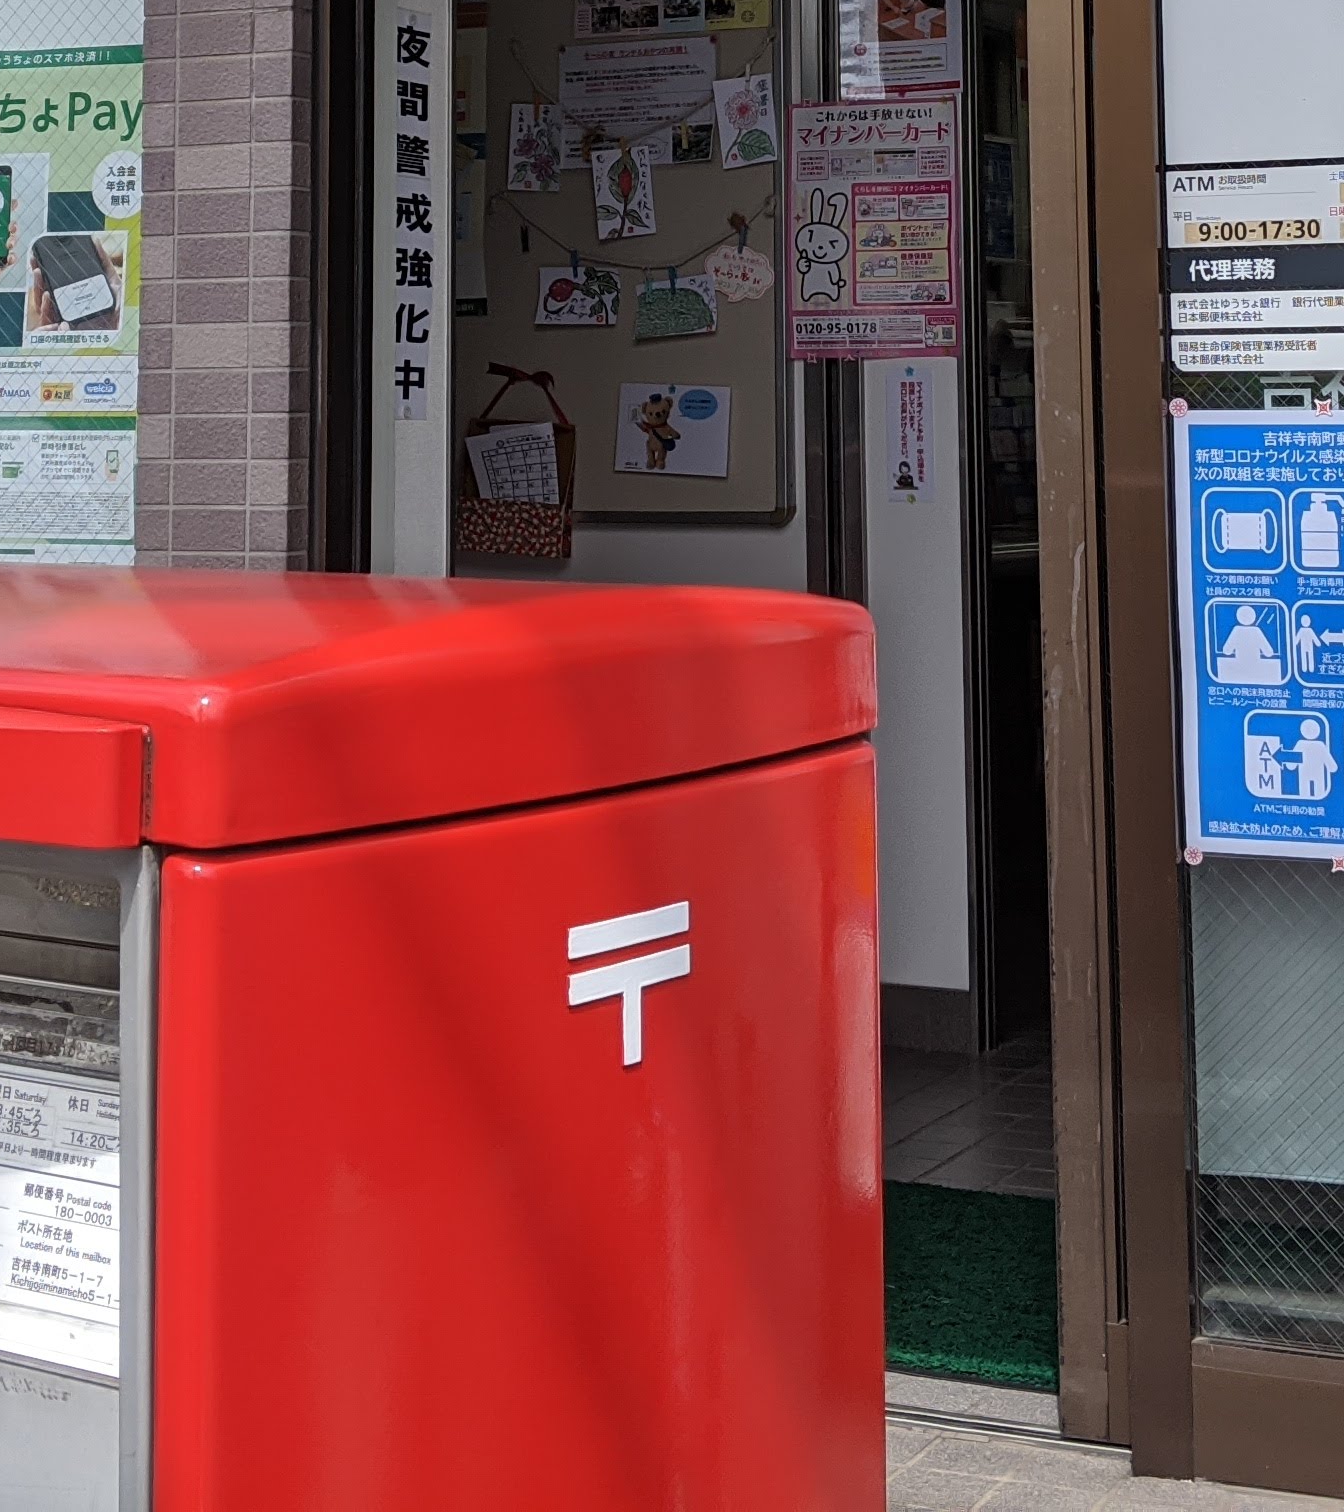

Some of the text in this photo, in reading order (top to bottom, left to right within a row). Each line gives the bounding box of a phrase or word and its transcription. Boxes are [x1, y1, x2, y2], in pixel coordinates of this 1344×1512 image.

[814, 106, 934, 124] これからは手放せない!
[796, 121, 951, 148] マイナンバーカード
[106, 165, 136, 178] 入会金
[1172, 176, 1215, 193] ATM
[395, 25, 434, 401] 夜間警戒強化中
[1172, 211, 1192, 222] 平日
[1199, 219, 1320, 242] 9:00-17:30
[1189, 258, 1276, 281] 代理業務
[1177, 296, 1281, 309] 株式会社ゆうちょ銀行
[1178, 310, 1264, 324] 日本郵便株式会社
[796, 322, 877, 335] 0120-95-0178
[1178, 352, 1264, 366] 日本郵便株式会社
[1258, 740, 1275, 790] ATM
[14, 1090, 47, 1106] Saturday
[68, 1095, 90, 1113] 休日
[23, 1182, 91, 1208] 郵便番号 Postal
[54, 1205, 114, 1228] 180-0003
[17, 1219, 74, 1244] ポスト所在地
[20, 1236, 53, 1254] Location
[10, 1256, 104, 1288] 吉祥寺南町5-1-7
